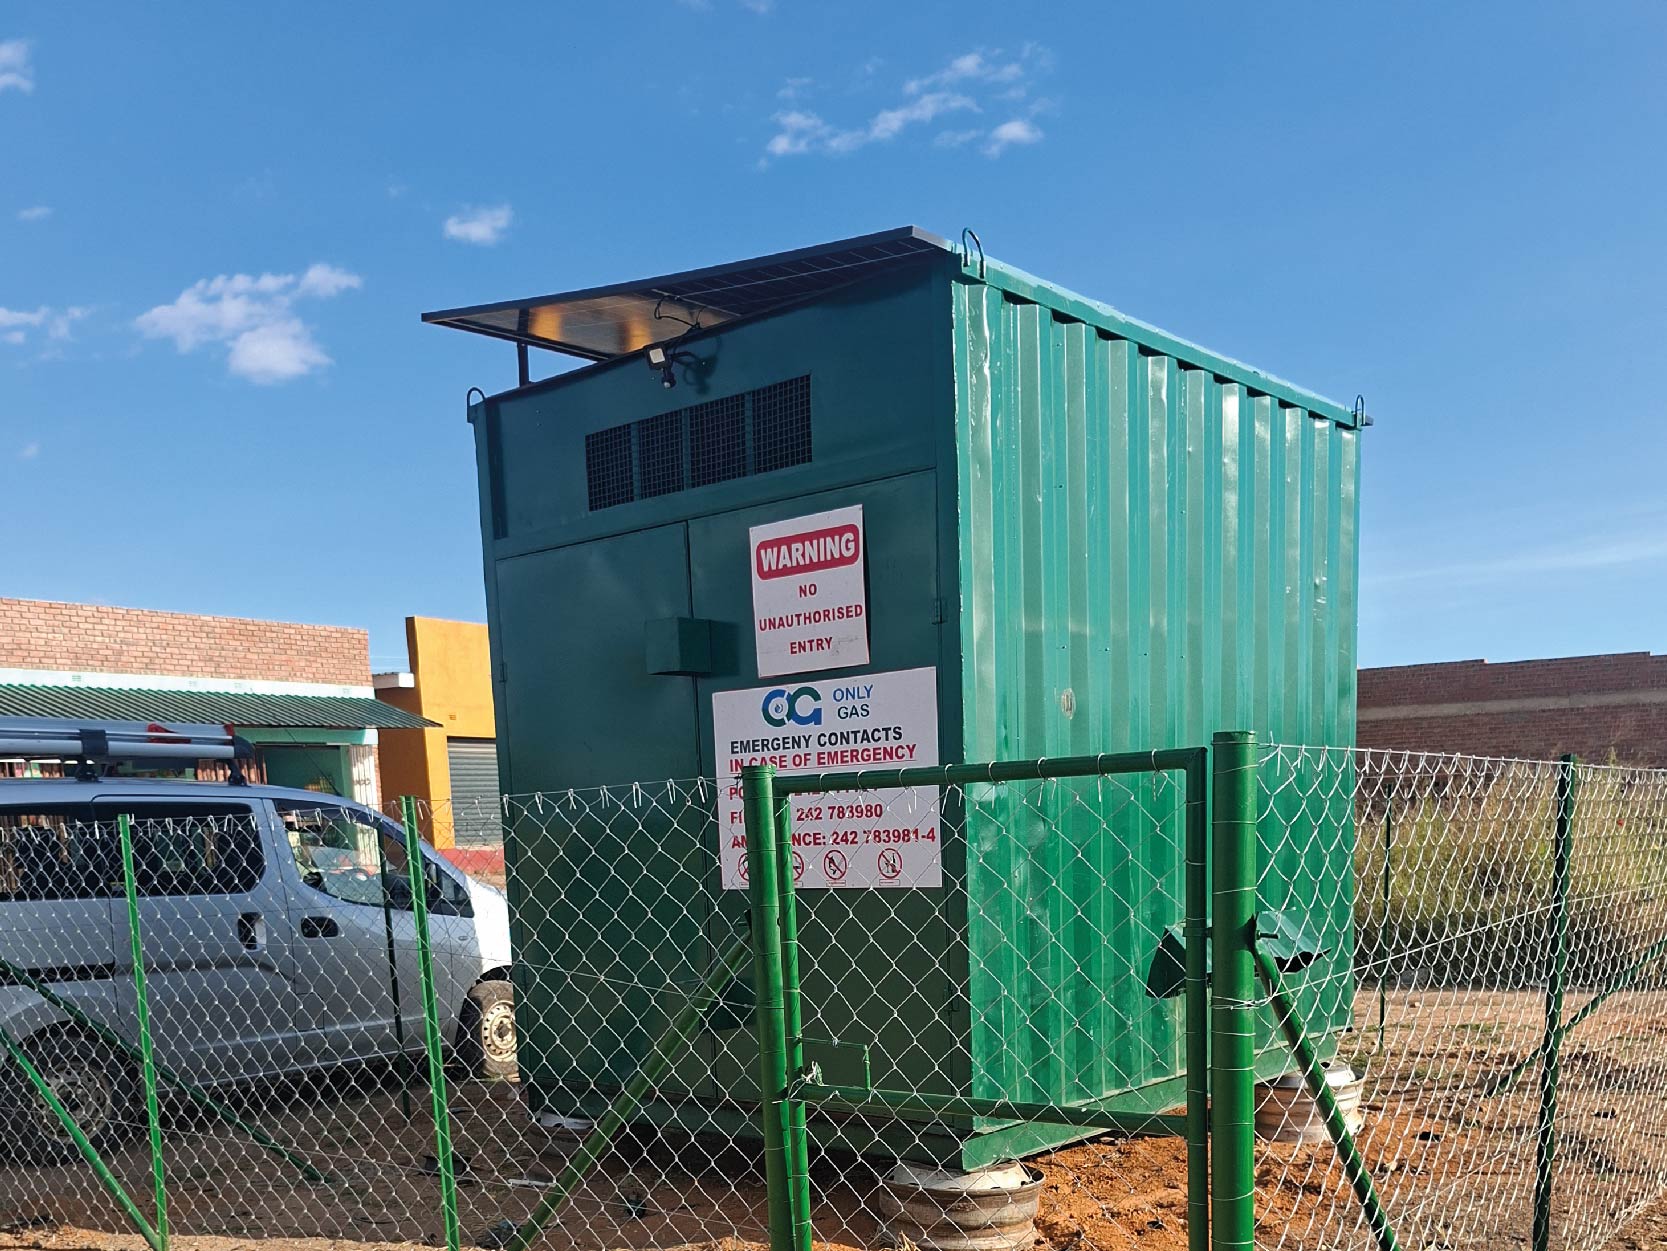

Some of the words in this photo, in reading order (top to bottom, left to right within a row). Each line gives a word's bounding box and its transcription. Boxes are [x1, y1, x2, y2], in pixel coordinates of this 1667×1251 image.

[760, 532, 856, 572] WARNING
[799, 583, 817, 598] NO
[759, 604, 863, 632] UNAUTHORISED
[790, 636, 833, 655] ENTRY
[832, 684, 874, 703] ONLY
[837, 703, 870, 720] GAS
[730, 734, 812, 755] EMERGENY
[817, 726, 903, 748] CONTACTS
[729, 758, 744, 772] IN
[748, 755, 788, 769] CASE
[792, 753, 812, 767] OF
[817, 743, 917, 766] EMERGENCY
[796, 807, 823, 822] 242
[828, 803, 883, 820] 783980
[830, 830, 858, 846] 242
[863, 827, 936, 844] 783981-4
